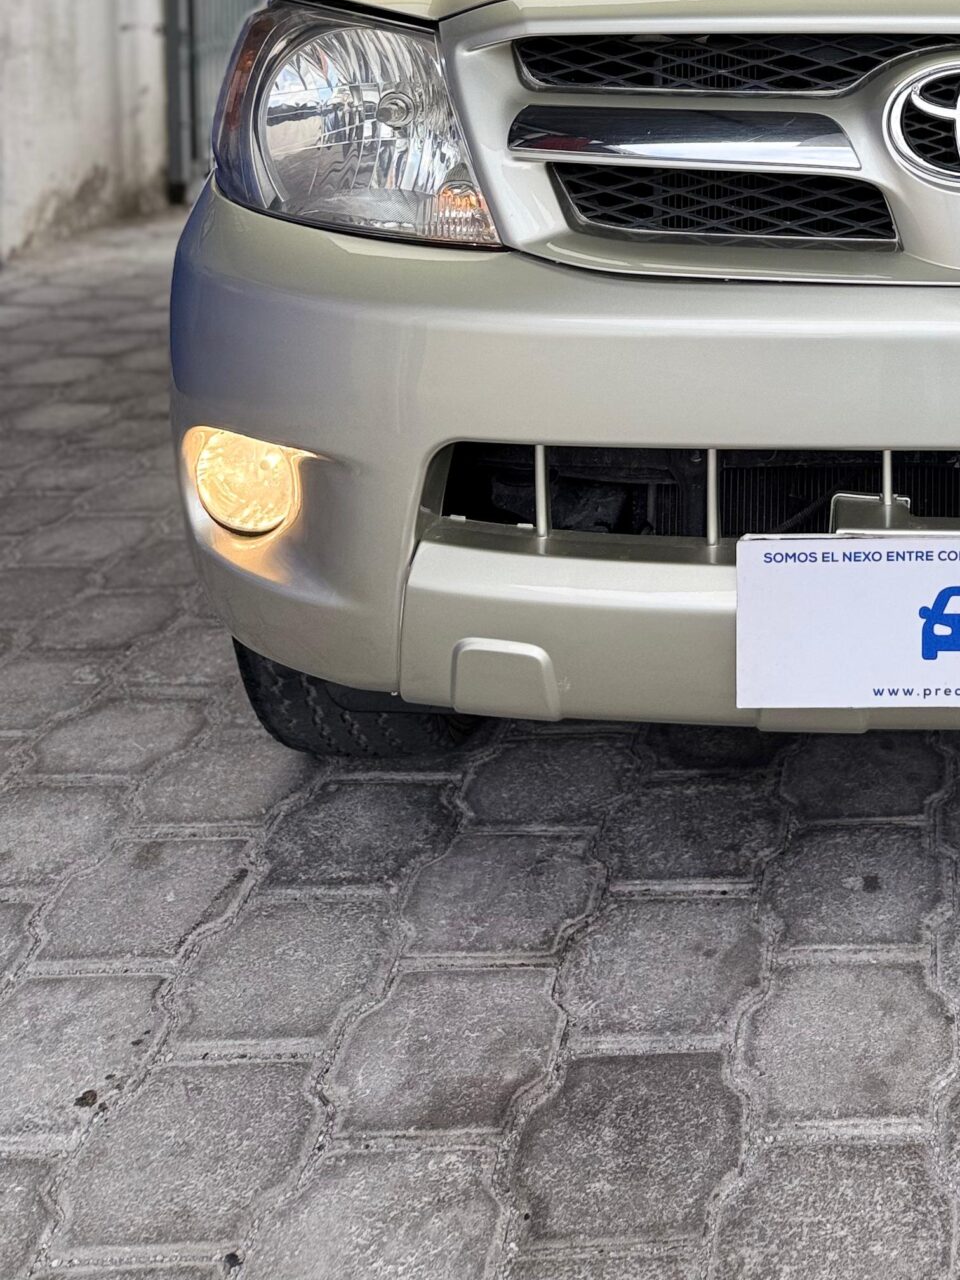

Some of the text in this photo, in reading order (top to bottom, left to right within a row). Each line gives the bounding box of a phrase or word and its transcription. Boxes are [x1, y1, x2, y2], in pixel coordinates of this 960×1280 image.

[763, 552, 817, 564] SOMOS
[821, 551, 839, 563] EL
[842, 551, 883, 563] NEXO
[886, 550, 934, 562] ENTRE
